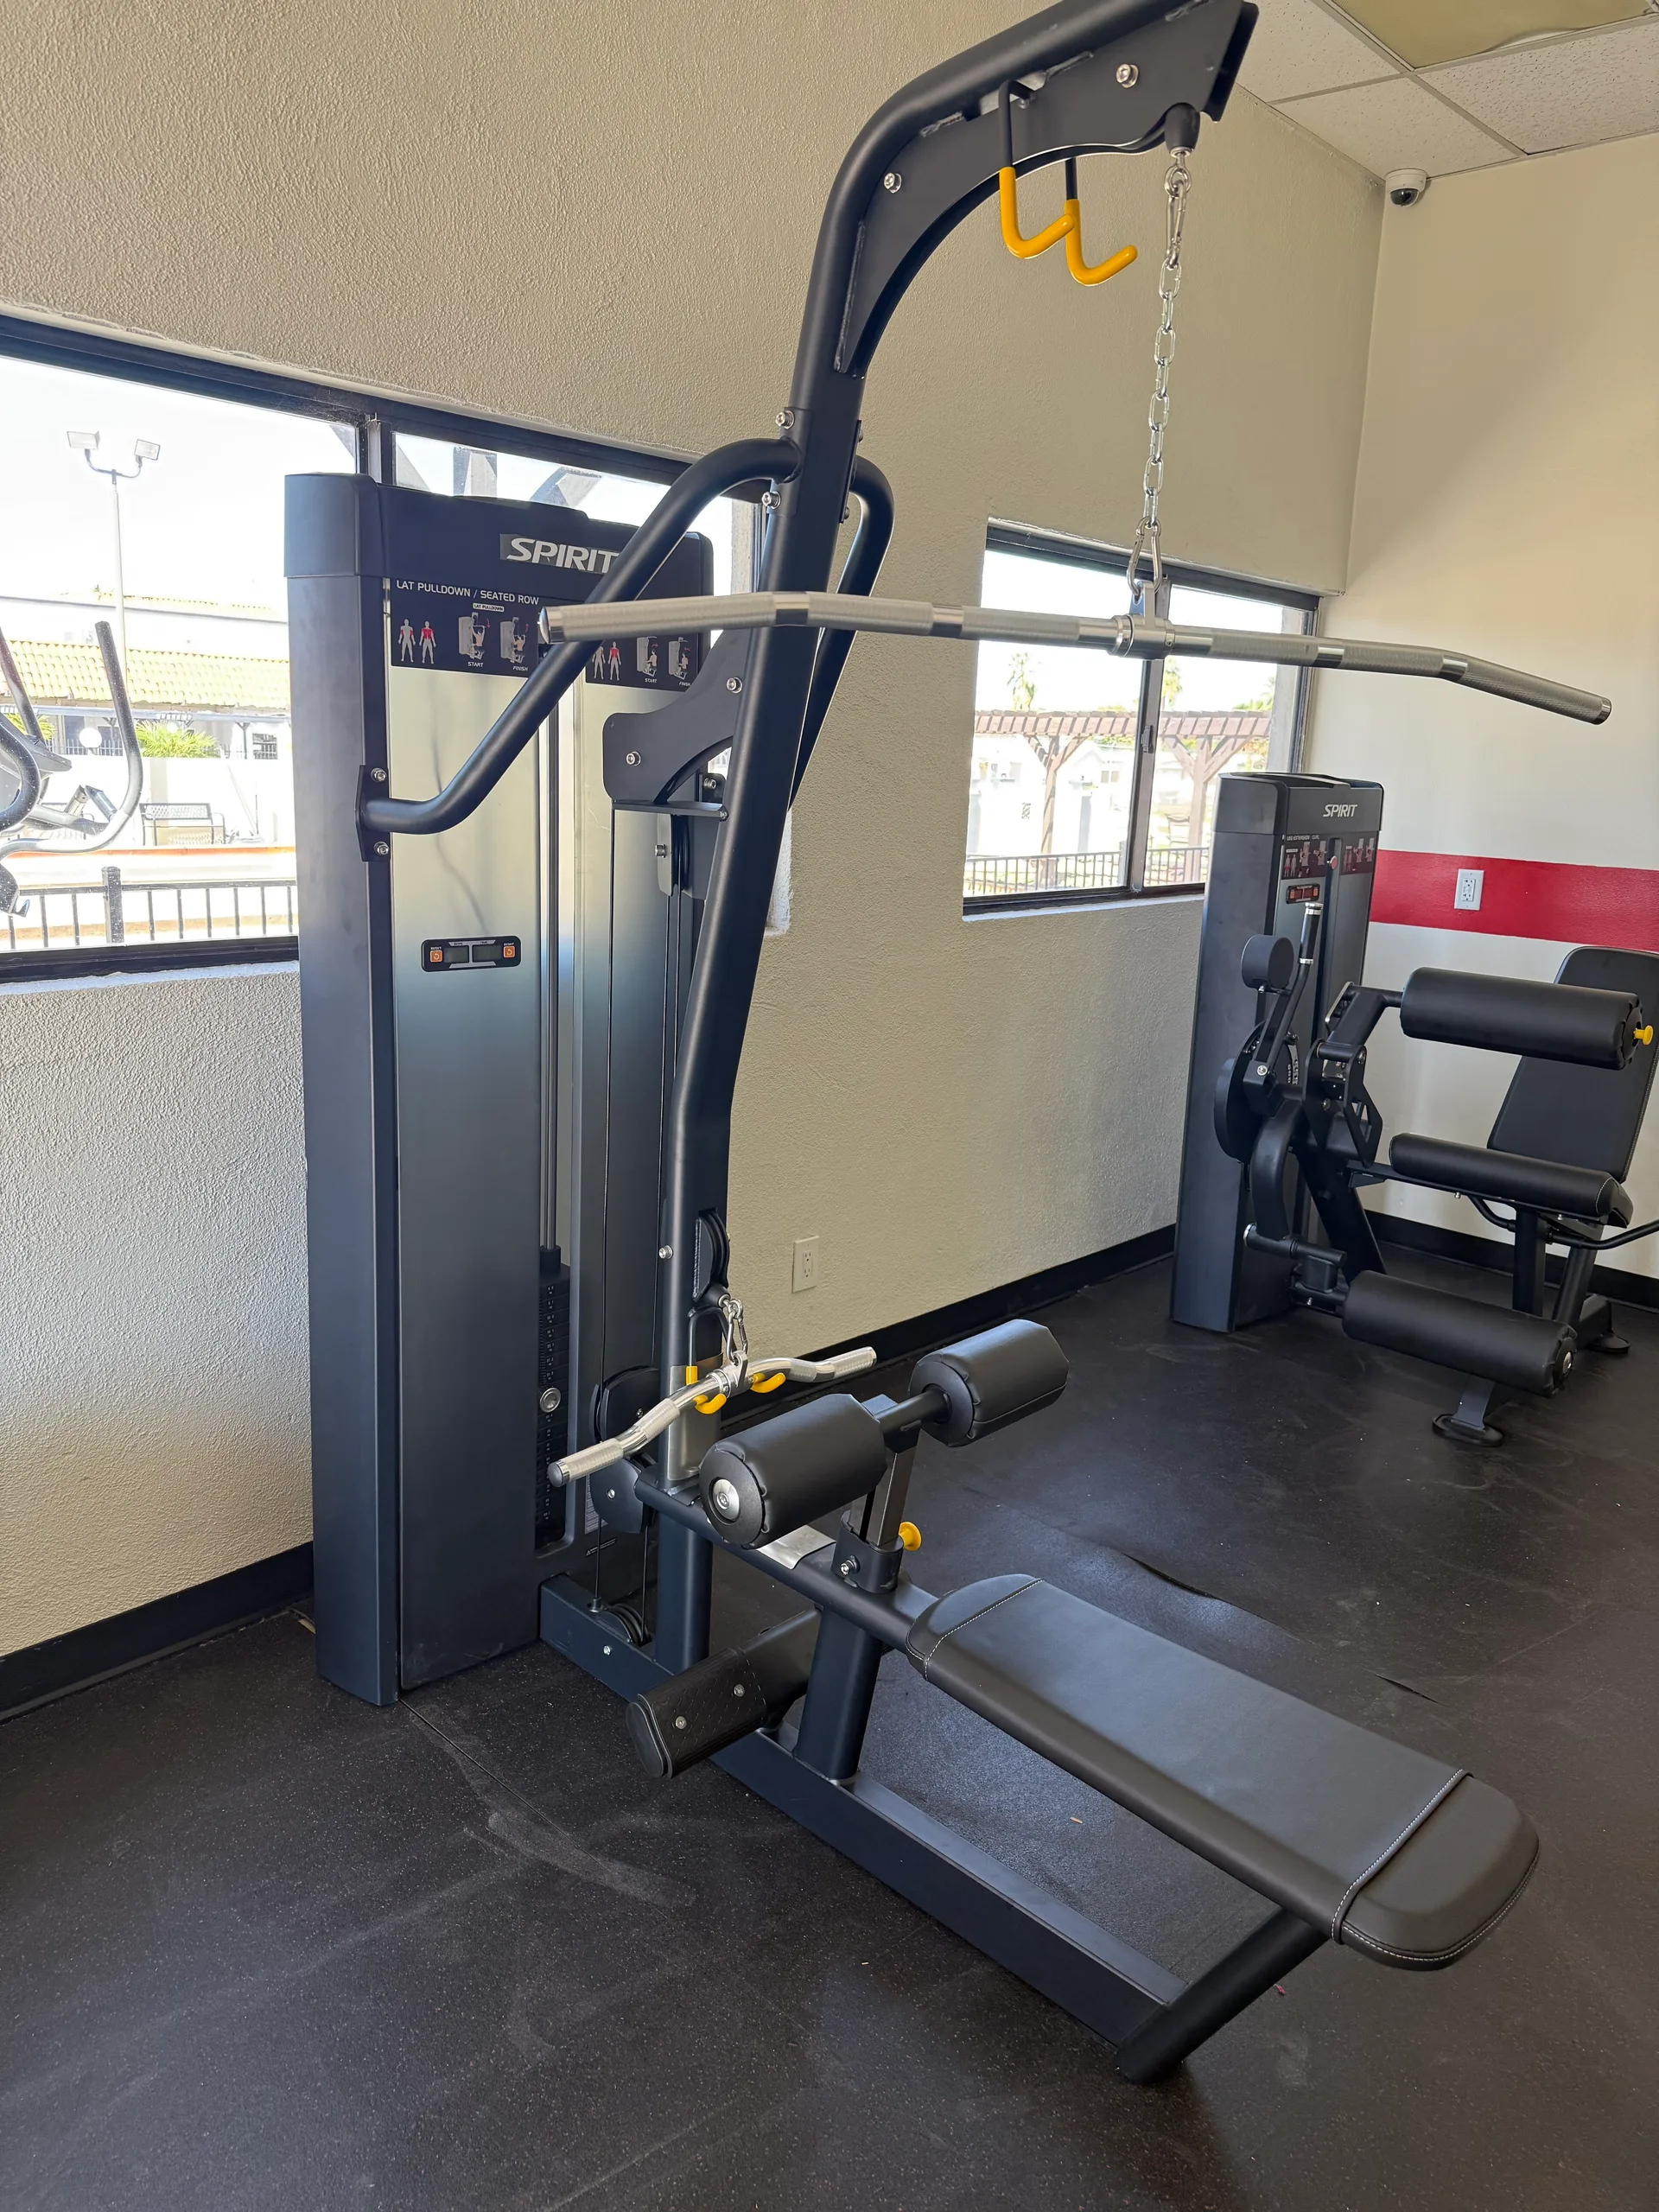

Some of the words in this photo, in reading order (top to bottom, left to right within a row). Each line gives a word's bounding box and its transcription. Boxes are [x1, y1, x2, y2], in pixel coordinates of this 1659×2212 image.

[506, 537, 620, 574] SPIRIT
[396, 580, 415, 590] LAT
[417, 582, 471, 597] PULLDOWN
[474, 589, 478, 598] /
[480, 590, 515, 602] SEATED
[518, 594, 539, 605] ROW
[1322, 804, 1358, 817] SPIRIT
